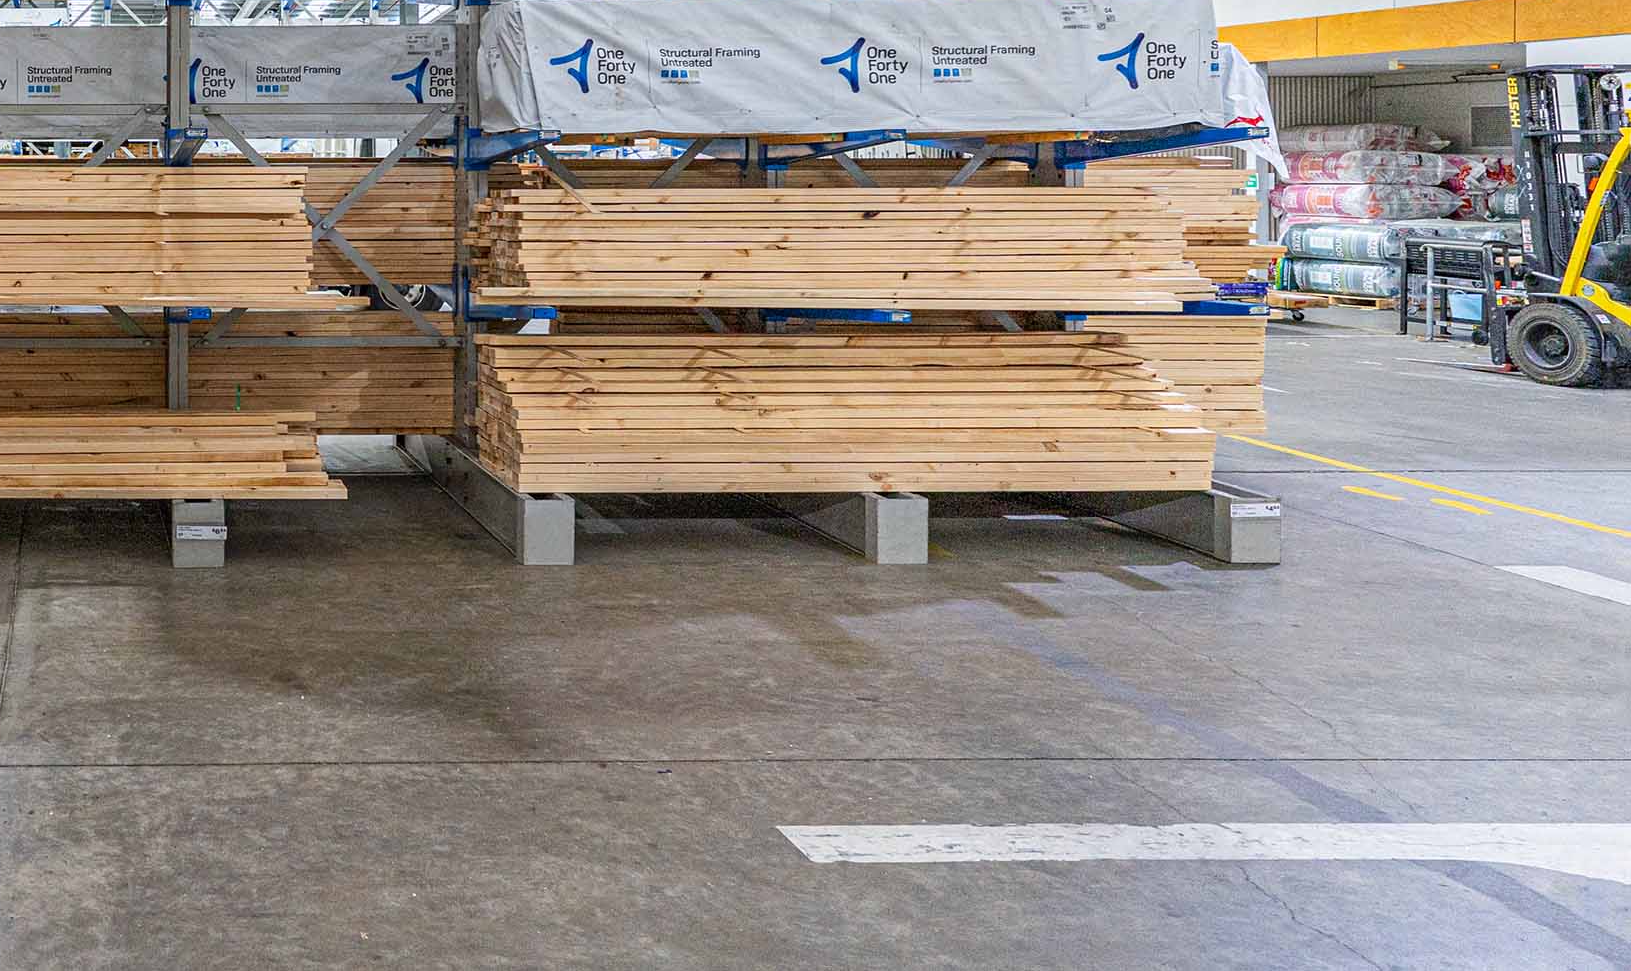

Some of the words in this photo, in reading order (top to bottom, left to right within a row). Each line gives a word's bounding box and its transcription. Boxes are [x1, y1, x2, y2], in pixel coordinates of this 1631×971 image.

[597, 47, 626, 59] One
[660, 47, 712, 57] Structural
[716, 47, 760, 58] Framing
[867, 47, 896, 58] One
[932, 45, 987, 55] Structural
[991, 45, 1035, 56] Framing
[1146, 42, 1176, 54] One
[661, 58, 712, 67] Untreated
[933, 55, 987, 65] Untreated
[1148, 55, 1186, 69] Forty
[28, 66, 72, 74] Structural
[75, 66, 112, 76] Framing
[202, 66, 226, 76] One
[256, 65, 301, 74] Structural
[304, 65, 341, 75] Framing
[598, 60, 636, 74] Forty
[868, 60, 908, 74] Forty
[256, 74, 301, 82] Untreated
[598, 72, 626, 84] One
[869, 72, 896, 84] One
[1148, 67, 1174, 79] One
[28, 75, 72, 83] Untreated
[203, 77, 235, 89] Forty
[202, 87, 226, 97] One
[1507, 77, 1521, 127] HYSTER
